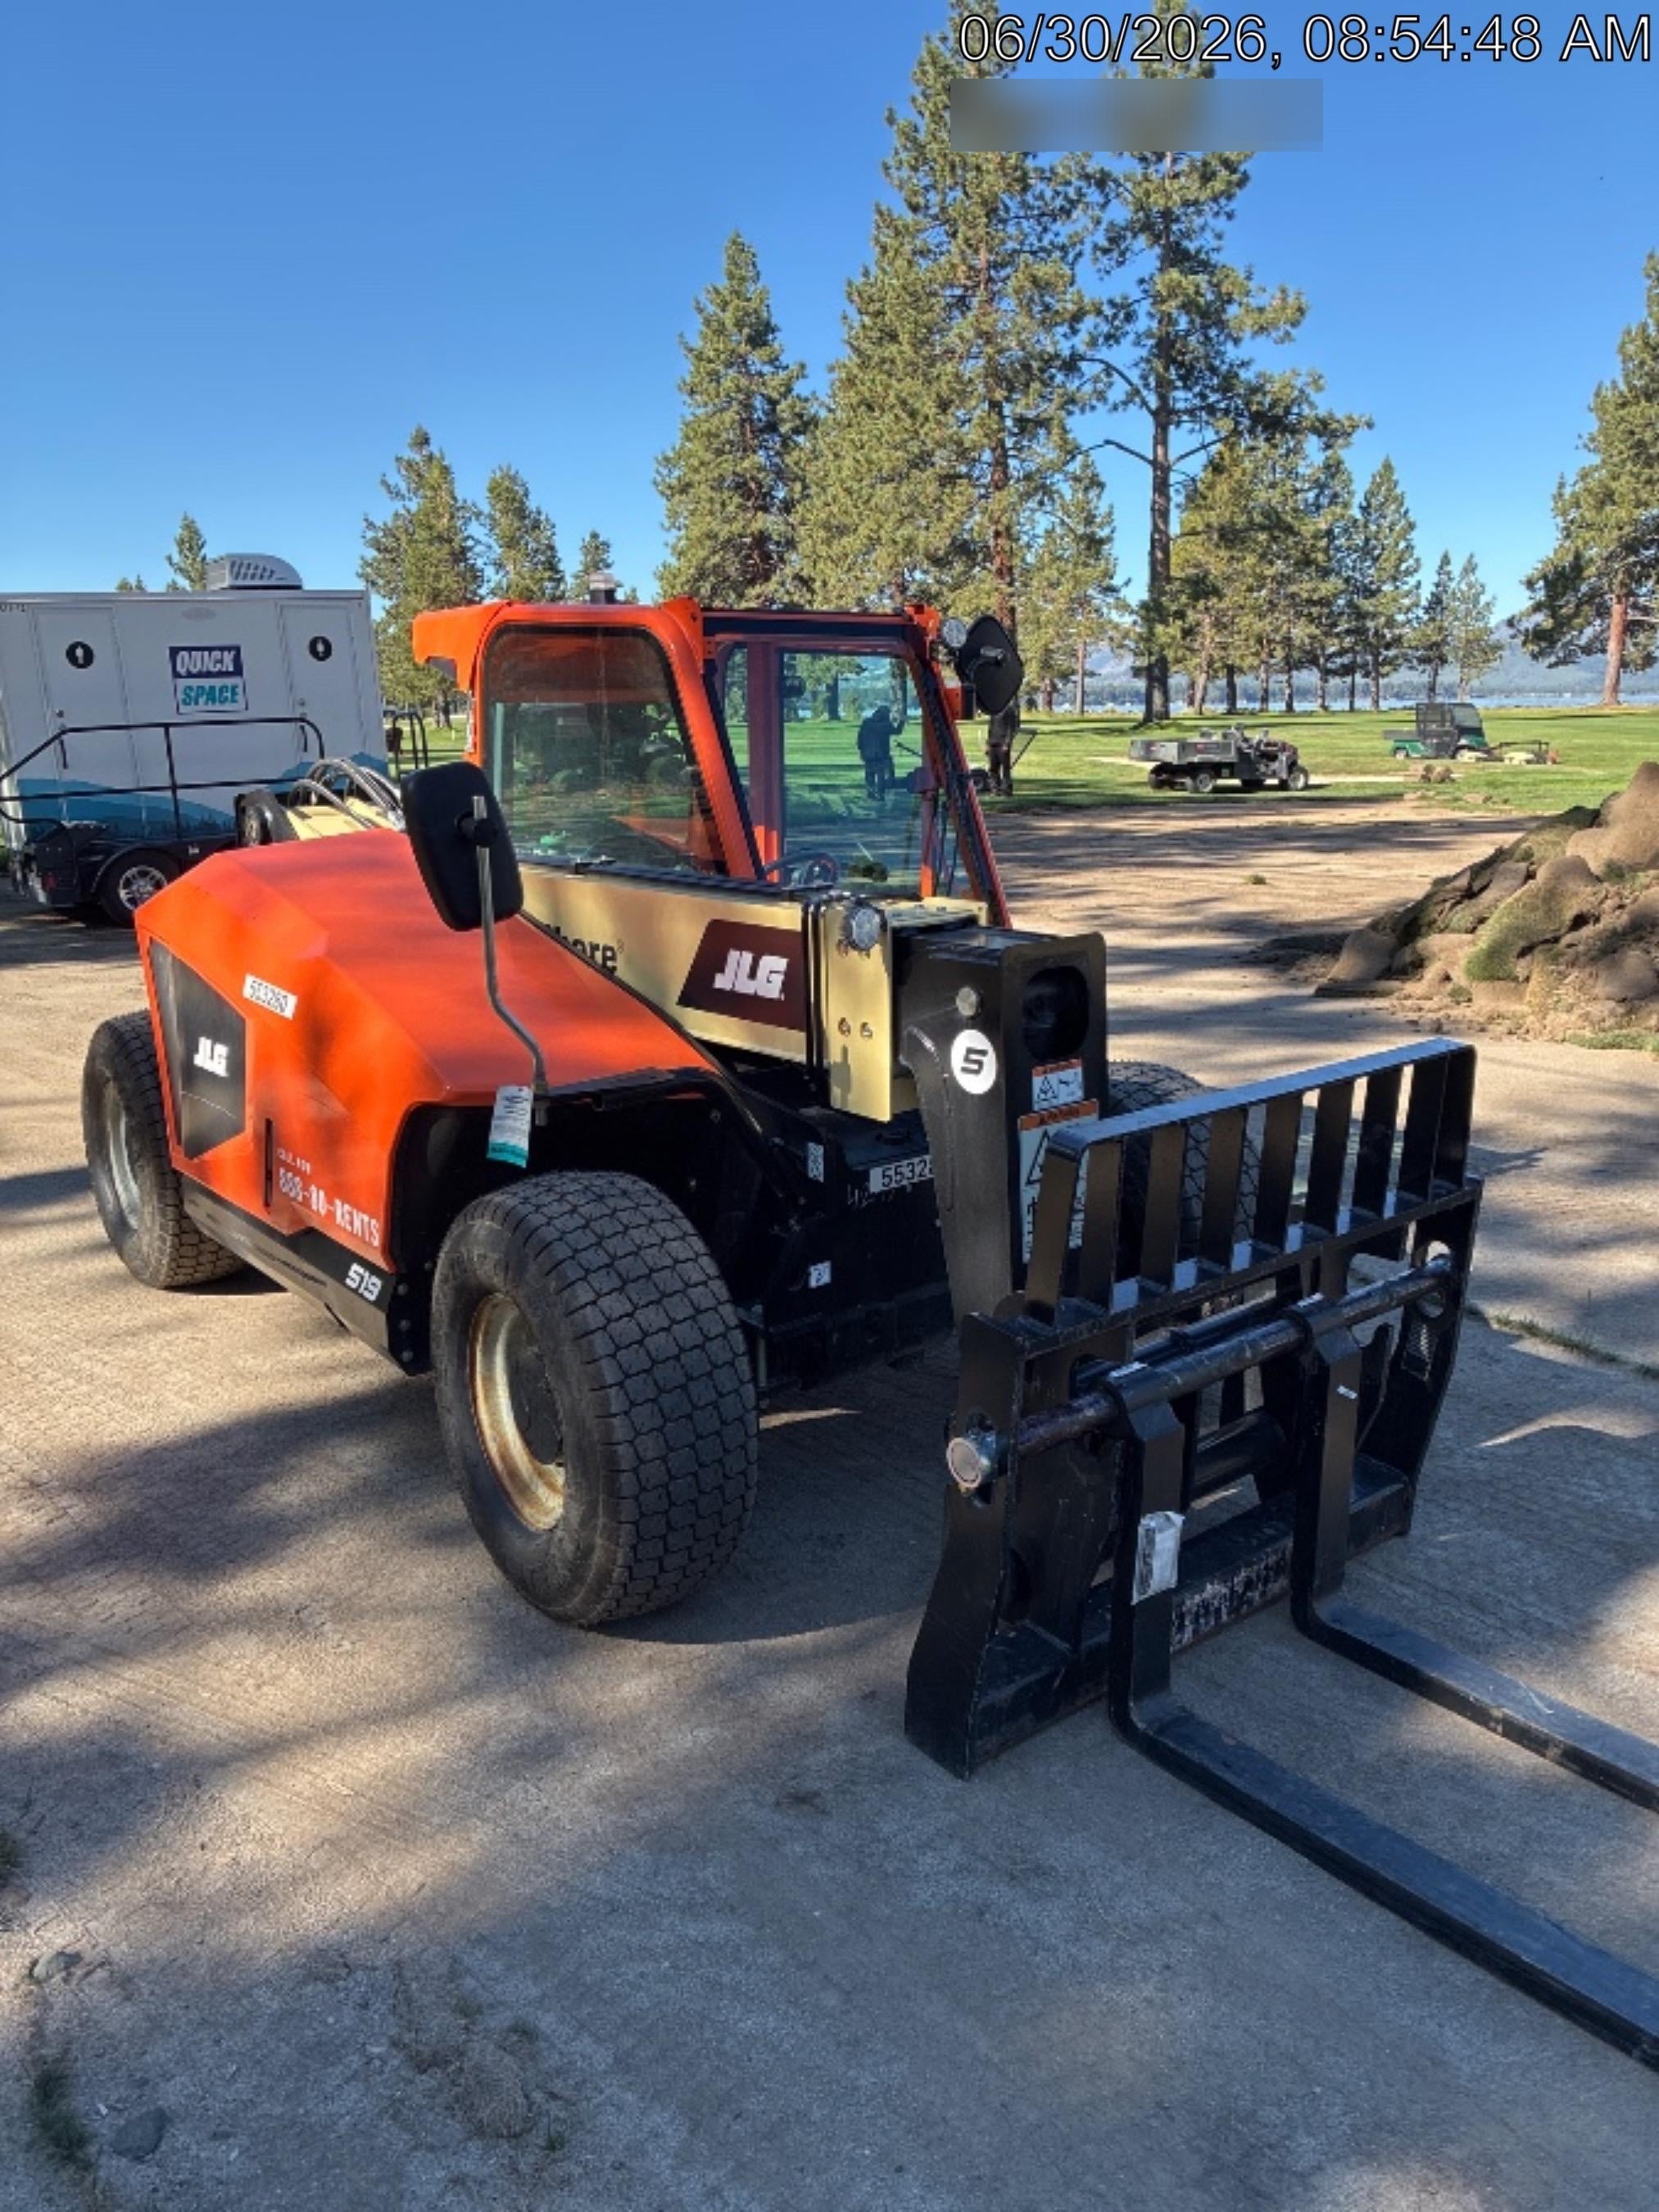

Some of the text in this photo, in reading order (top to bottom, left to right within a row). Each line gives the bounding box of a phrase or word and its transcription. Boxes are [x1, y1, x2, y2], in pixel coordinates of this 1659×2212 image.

[176, 650, 236, 676] QUICK
[182, 685, 238, 705] SPACE
[714, 949, 788, 999] JLG
[193, 1036, 229, 1077] JLG
[346, 1263, 382, 1301] 519
